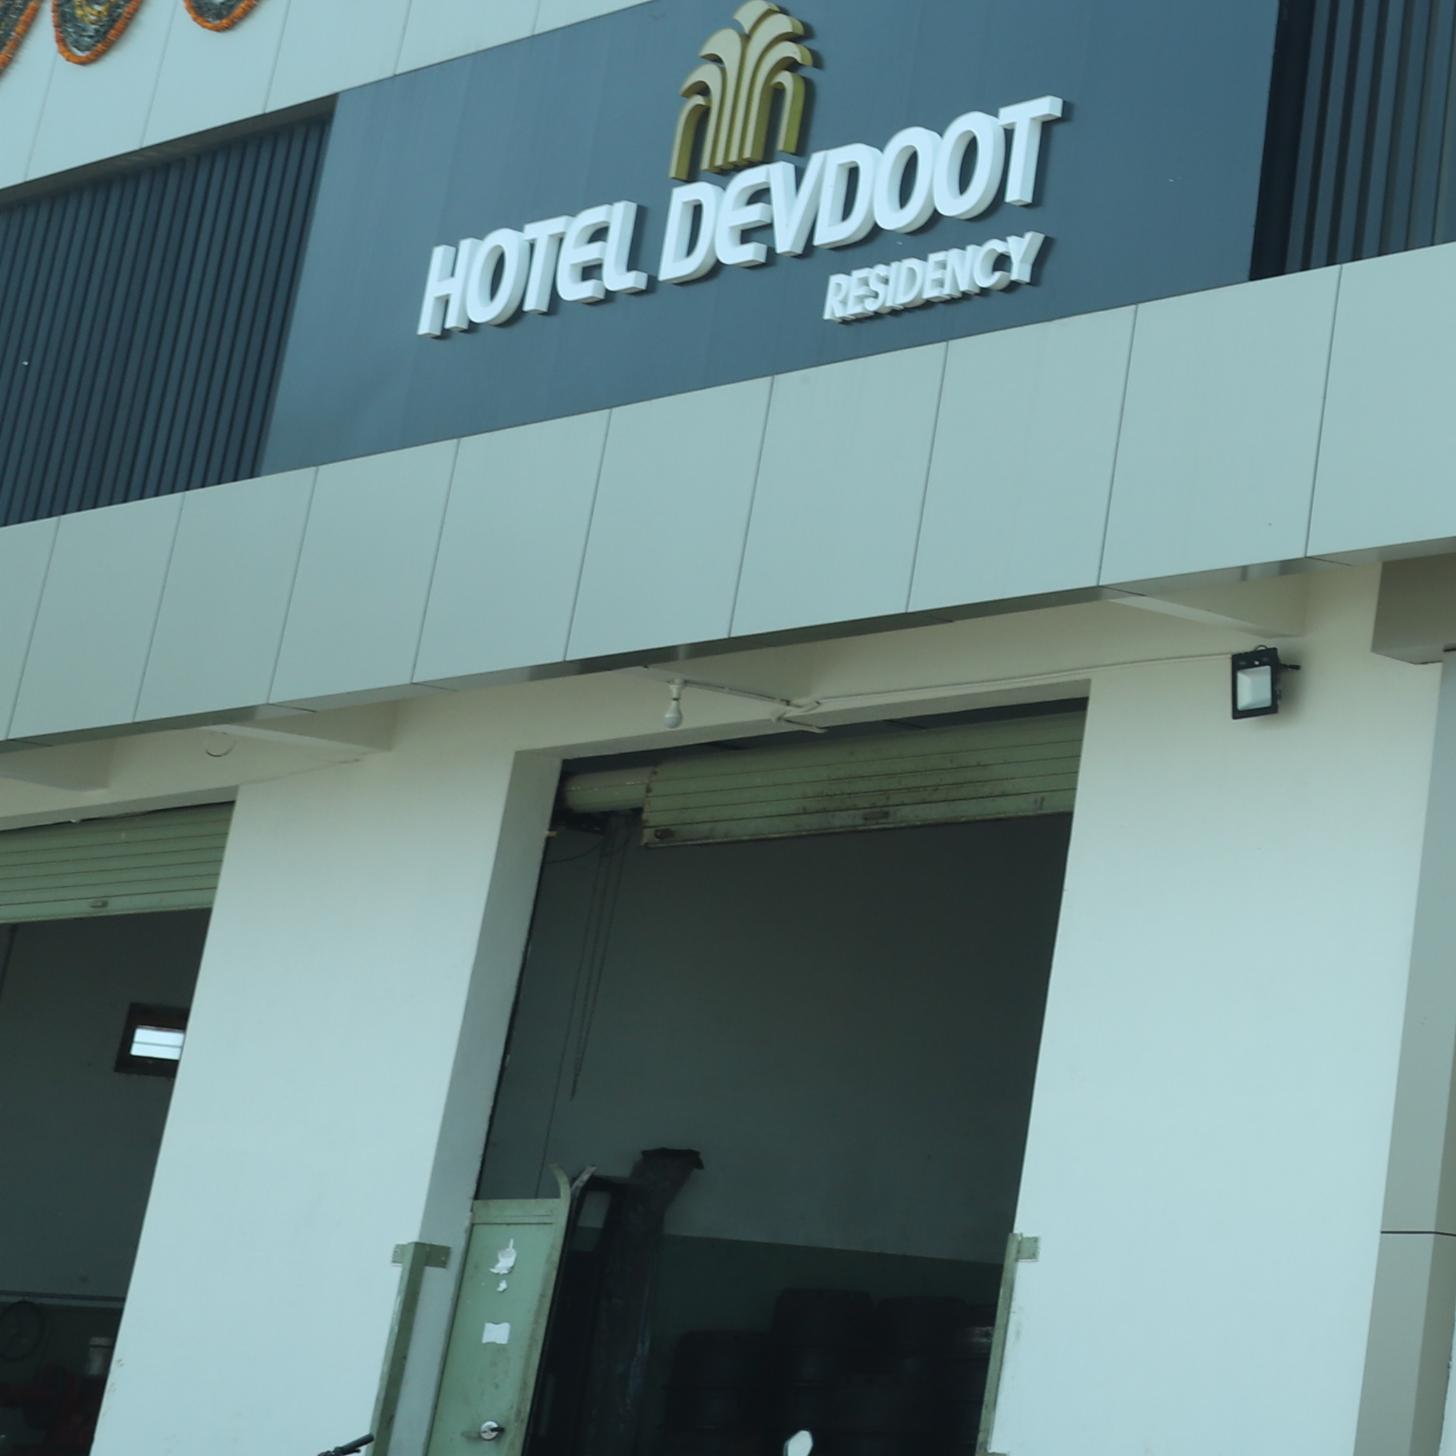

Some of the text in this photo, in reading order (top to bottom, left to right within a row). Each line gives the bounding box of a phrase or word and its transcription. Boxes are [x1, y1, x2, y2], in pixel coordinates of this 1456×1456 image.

[417, 95, 1063, 338] HOTEL DEVDOOT
[823, 231, 1046, 323] RESIDENCY
